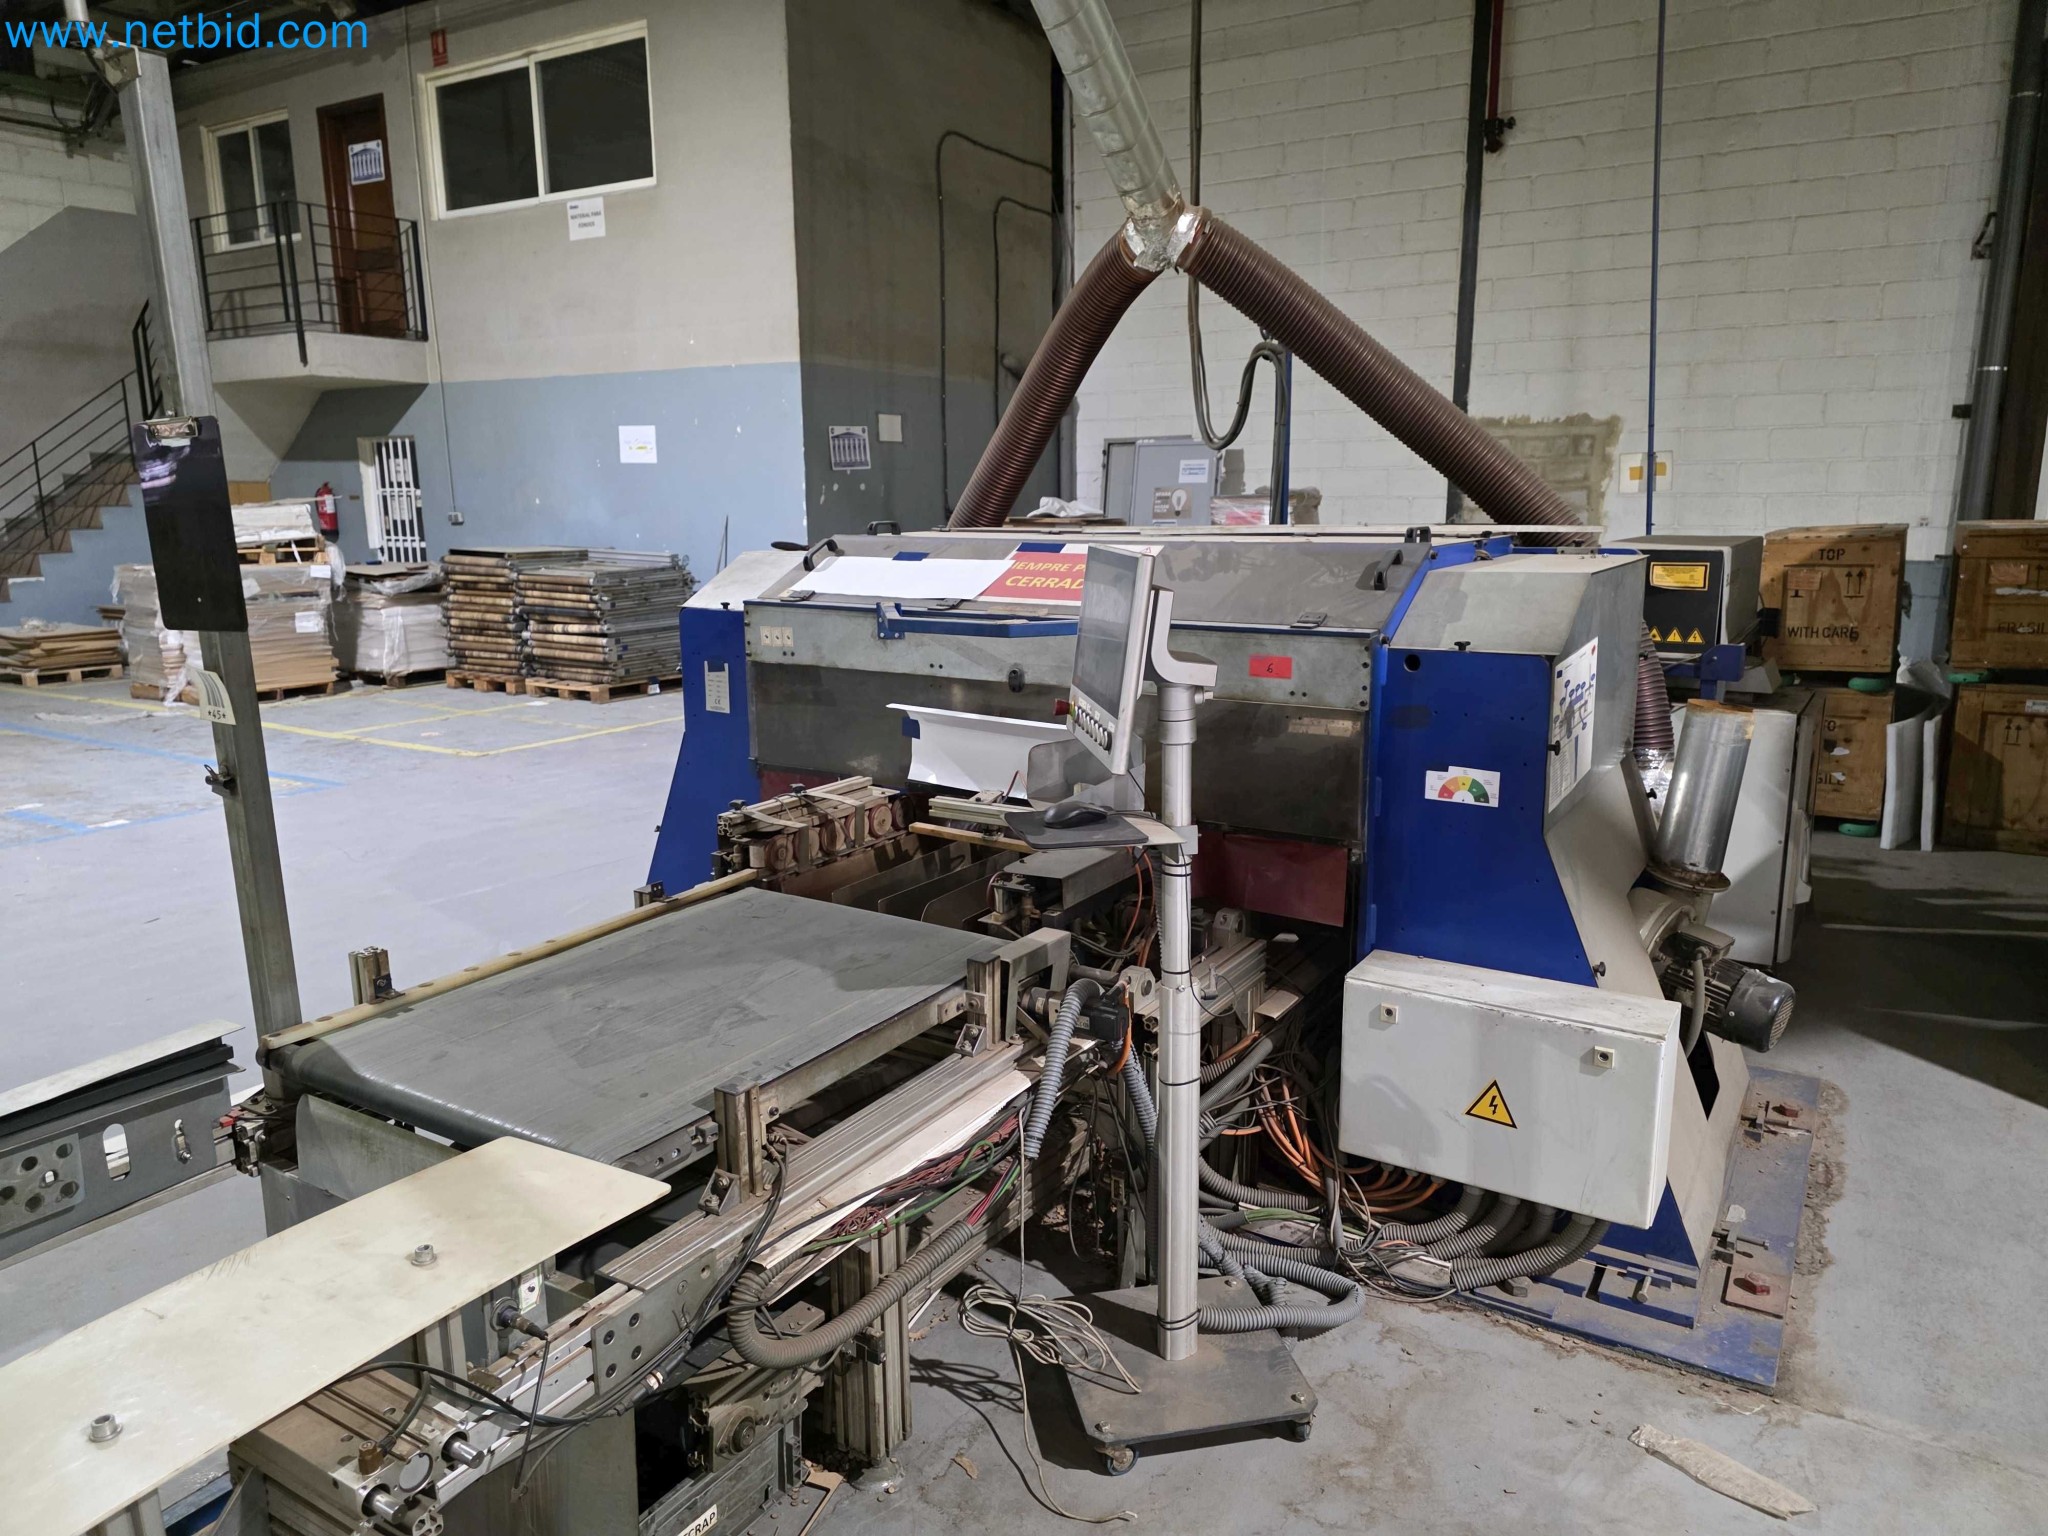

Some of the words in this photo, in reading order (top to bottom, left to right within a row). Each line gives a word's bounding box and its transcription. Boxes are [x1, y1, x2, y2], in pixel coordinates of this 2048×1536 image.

[1818, 548, 1846, 561] TOP
[1011, 561, 1073, 572] IEMPRE
[1072, 563, 1086, 573] P
[1005, 575, 1085, 590] CERRAD
[1787, 627, 1819, 639] WITH
[683, 1511, 716, 1536] CRAP
